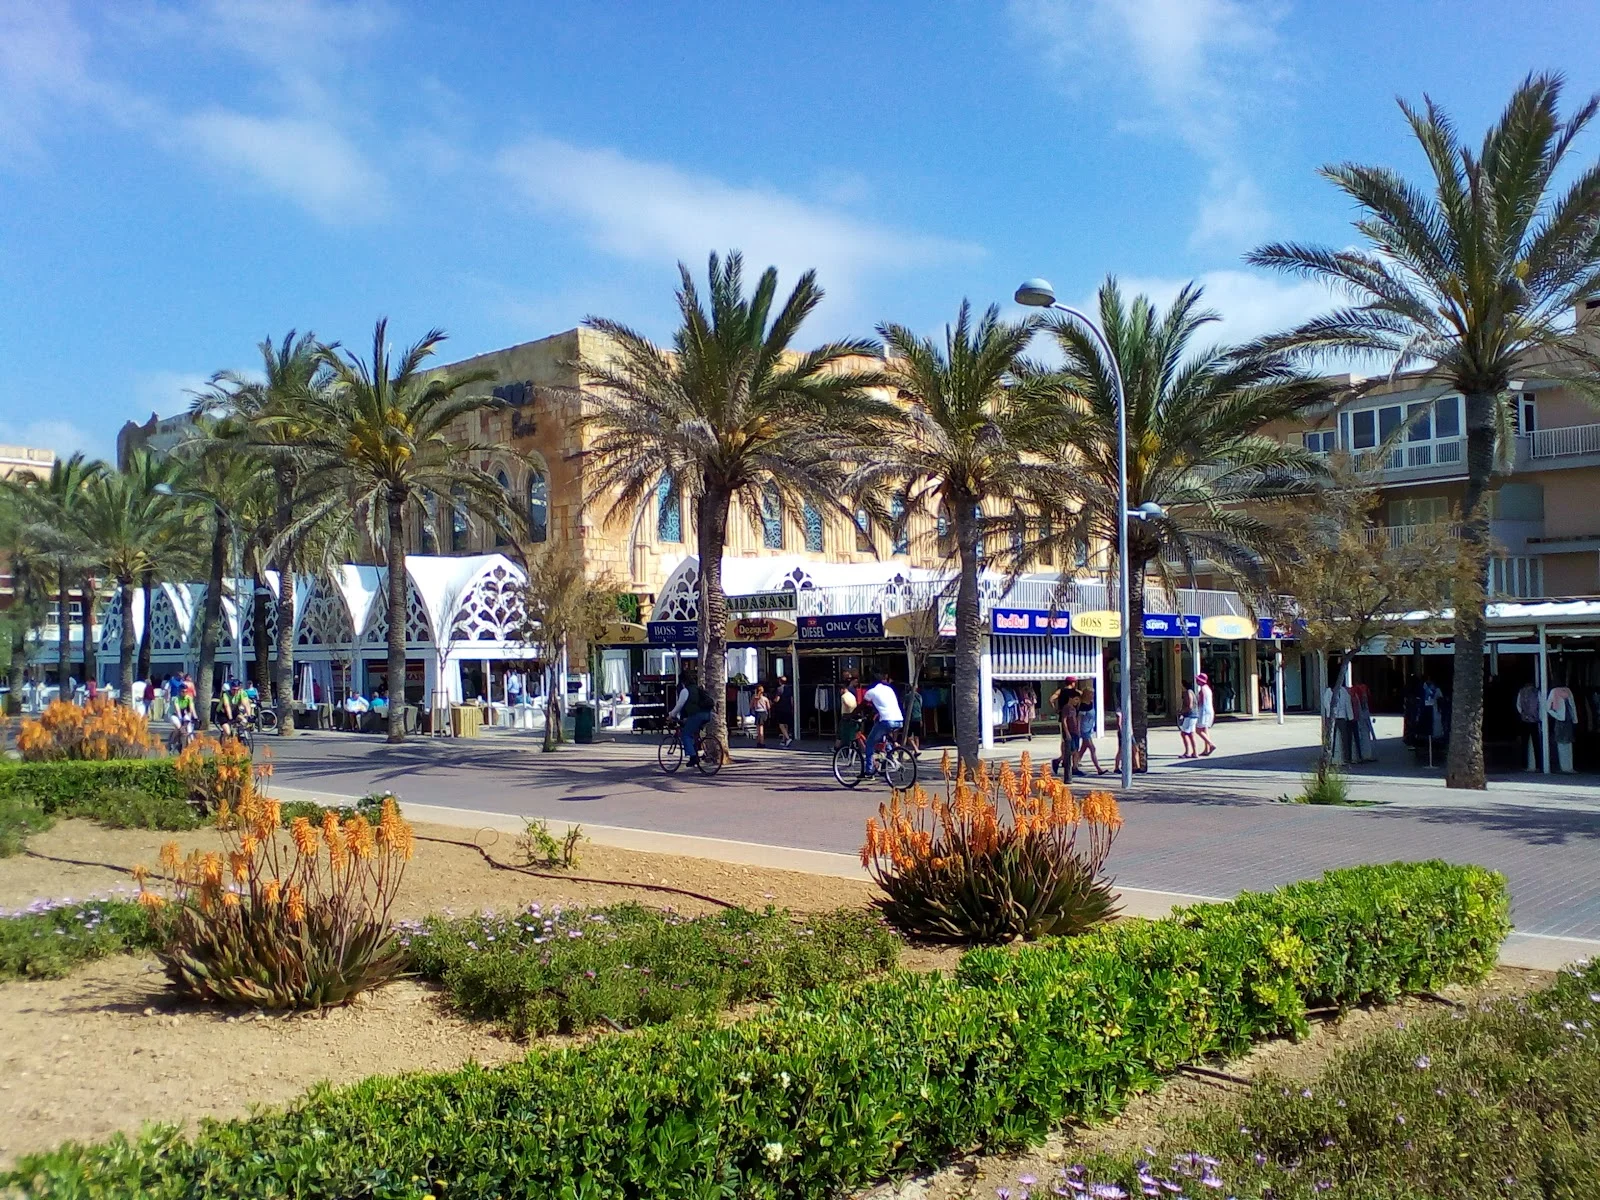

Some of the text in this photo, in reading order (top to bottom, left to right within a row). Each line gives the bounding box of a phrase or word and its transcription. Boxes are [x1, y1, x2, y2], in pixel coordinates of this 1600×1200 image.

[826, 621, 851, 631] ONLY
[1080, 617, 1102, 627] BOSS
[654, 626, 676, 636] BOSS
[801, 627, 825, 638] DIESEL
